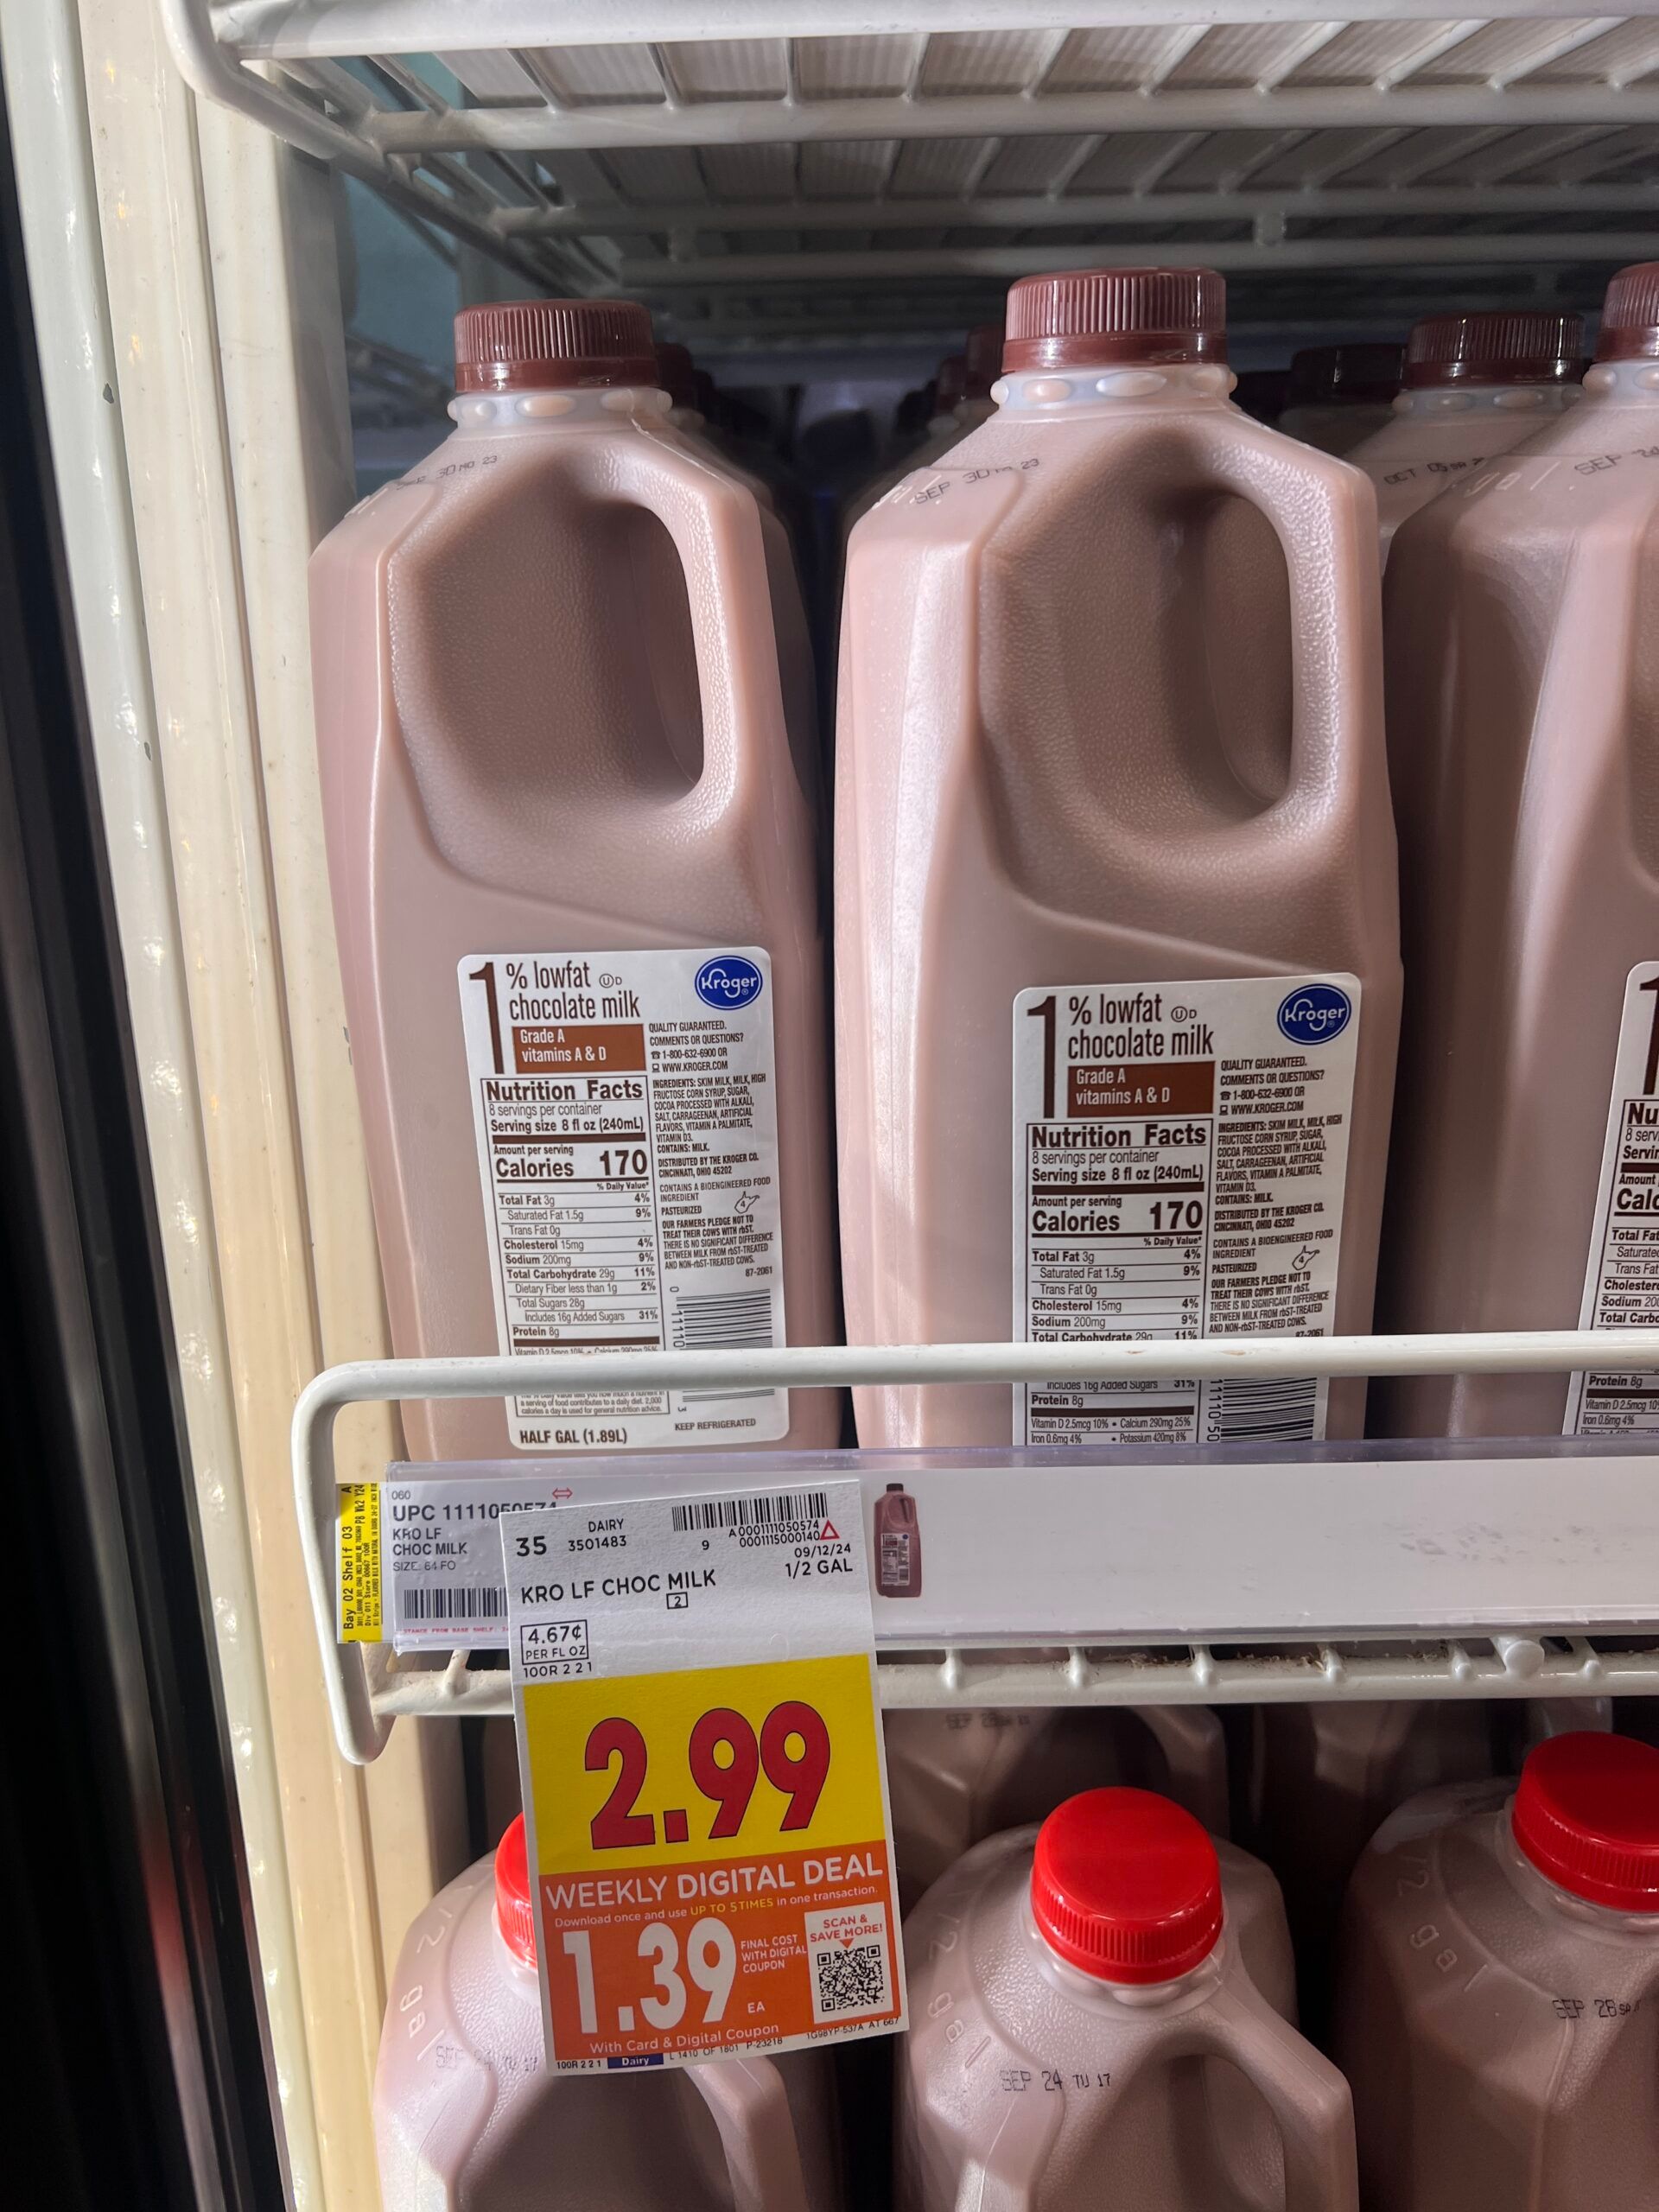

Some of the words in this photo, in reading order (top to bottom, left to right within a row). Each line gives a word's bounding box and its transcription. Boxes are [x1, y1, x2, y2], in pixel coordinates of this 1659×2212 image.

[1383, 468, 1416, 485] OCT
[914, 481, 950, 505] SEP
[505, 962, 528, 989] %
[533, 959, 591, 988] lowfat
[701, 968, 757, 998] Kroger
[509, 991, 595, 1020] chocolate
[601, 989, 640, 1018] milk
[1069, 995, 1091, 1026] %
[1099, 991, 1162, 1025] lowfat
[1285, 998, 1346, 1032] Kroger
[520, 1027, 554, 1044] Grade
[557, 1028, 565, 1043] A
[1068, 1027, 1164, 1059] chocolate
[1171, 1023, 1214, 1056] milk
[521, 1046, 572, 1062] vitamins
[575, 1046, 582, 1061] A
[585, 1046, 595, 1061] &
[598, 1046, 607, 1060] D
[661, 1060, 728, 1072] WWW.KROGER.COM
[486, 1080, 575, 1101] Nutrition
[586, 1079, 643, 1099] Facts
[488, 1103, 495, 1116] 8
[497, 1103, 537, 1119] servings
[539, 1105, 556, 1119] per
[557, 1103, 602, 1116] container
[490, 1119, 531, 1134] Serving
[534, 1118, 556, 1132] size
[562, 1118, 569, 1131] 8
[571, 1118, 580, 1131] fl
[582, 1121, 596, 1131] oz
[599, 1116, 643, 1133] (240mL)
[1032, 1124, 1131, 1148] Nutrition
[1144, 1122, 1206, 1146] Facts
[493, 1145, 525, 1156] Amount
[527, 1147, 542, 1157] per
[543, 1143, 574, 1159] serving
[495, 1159, 574, 1178] Calories
[599, 1148, 647, 1176] 170
[1032, 1210, 1120, 1231] Calories
[1149, 1199, 1203, 1230] 170
[675, 1422, 695, 1431] KEEP
[696, 1418, 756, 1430] REFRIGERATED
[519, 1430, 550, 1444] HALF
[555, 1429, 580, 1444] GAL
[582, 1427, 627, 1445] (1.89L)
[354, 1484, 365, 1497] Y24
[391, 1490, 411, 1500] 060
[354, 1516, 365, 1524] P8
[393, 1504, 435, 1522] UPC
[341, 1526, 353, 1540] 03
[392, 1528, 422, 1541] KRO
[426, 1527, 442, 1540] LF
[588, 1517, 624, 1533] DAIRY
[515, 1535, 547, 1557] 35
[568, 1535, 626, 1552] 3501483
[701, 1540, 709, 1550] 9
[740, 1530, 820, 1548] 0001115000140
[392, 1542, 431, 1556] CHOC
[435, 1541, 467, 1554] MILK
[794, 1542, 851, 1558] 09/12/24
[342, 1547, 353, 1581] Shelf
[423, 1561, 437, 1571] 64
[440, 1560, 456, 1570] FO
[785, 1560, 811, 1580] 1/2
[817, 1557, 853, 1574] GAL
[343, 1588, 353, 1602] 02
[520, 1583, 563, 1604] KRO
[571, 1580, 594, 1599] LF
[601, 1573, 660, 1596] CHOC
[668, 1568, 715, 1590] MILK
[674, 1596, 683, 1608] 2
[343, 1608, 355, 1630] Bay
[528, 1625, 582, 1644] 4.67¢
[525, 1649, 548, 1660] PER
[551, 1647, 565, 1657] FL
[569, 1645, 588, 1657] OZ
[523, 1664, 557, 1678] 100R
[563, 1663, 570, 1675] 2
[575, 1662, 582, 1674] 2
[587, 1662, 591, 1672] 1
[584, 1700, 830, 1850] 2.99
[545, 1875, 667, 1910] WEEKLY
[677, 1863, 796, 1898] DIGITAL
[803, 1852, 883, 1885] DEAL
[555, 1913, 611, 1927] Download
[613, 1913, 640, 1922] once
[644, 1909, 664, 1920] and
[668, 1909, 687, 1918] use
[690, 1905, 706, 1916] UP
[709, 1903, 725, 1913] TO
[730, 1901, 740, 1912] 5
[739, 1897, 773, 1910] TIMES
[777, 1897, 786, 1906] in
[789, 1895, 810, 1904] one
[813, 1885, 877, 1901] transaction.
[823, 1916, 856, 1929] SCAN
[859, 1913, 868, 1923] &
[741, 1938, 769, 1949] FINAL
[772, 1934, 798, 1947] COST
[810, 1929, 841, 1942] SAVE
[844, 1923, 884, 1937] MORE!
[741, 1950, 766, 1961] WITH
[769, 1944, 809, 1957] DIGITAL
[563, 1916, 737, 2034] 1.39
[742, 1959, 785, 1974] COUPON
[747, 2001, 765, 2013] EA
[1552, 1999, 1585, 2018] SEP
[1594, 1999, 1618, 2018] 28
[589, 2041, 621, 2053] With
[626, 2037, 658, 2051] Card
[663, 2036, 671, 2048] &
[677, 2030, 721, 2047] Digital
[726, 2024, 779, 2040] Coupon
[556, 2061, 578, 2069] 100R
[581, 2060, 586, 2069] 2
[619, 2057, 652, 2070] Dairy
[1000, 2069, 1032, 2092] SEP
[1041, 2069, 1063, 2091] 24
[1096, 2073, 1111, 2087] 17
